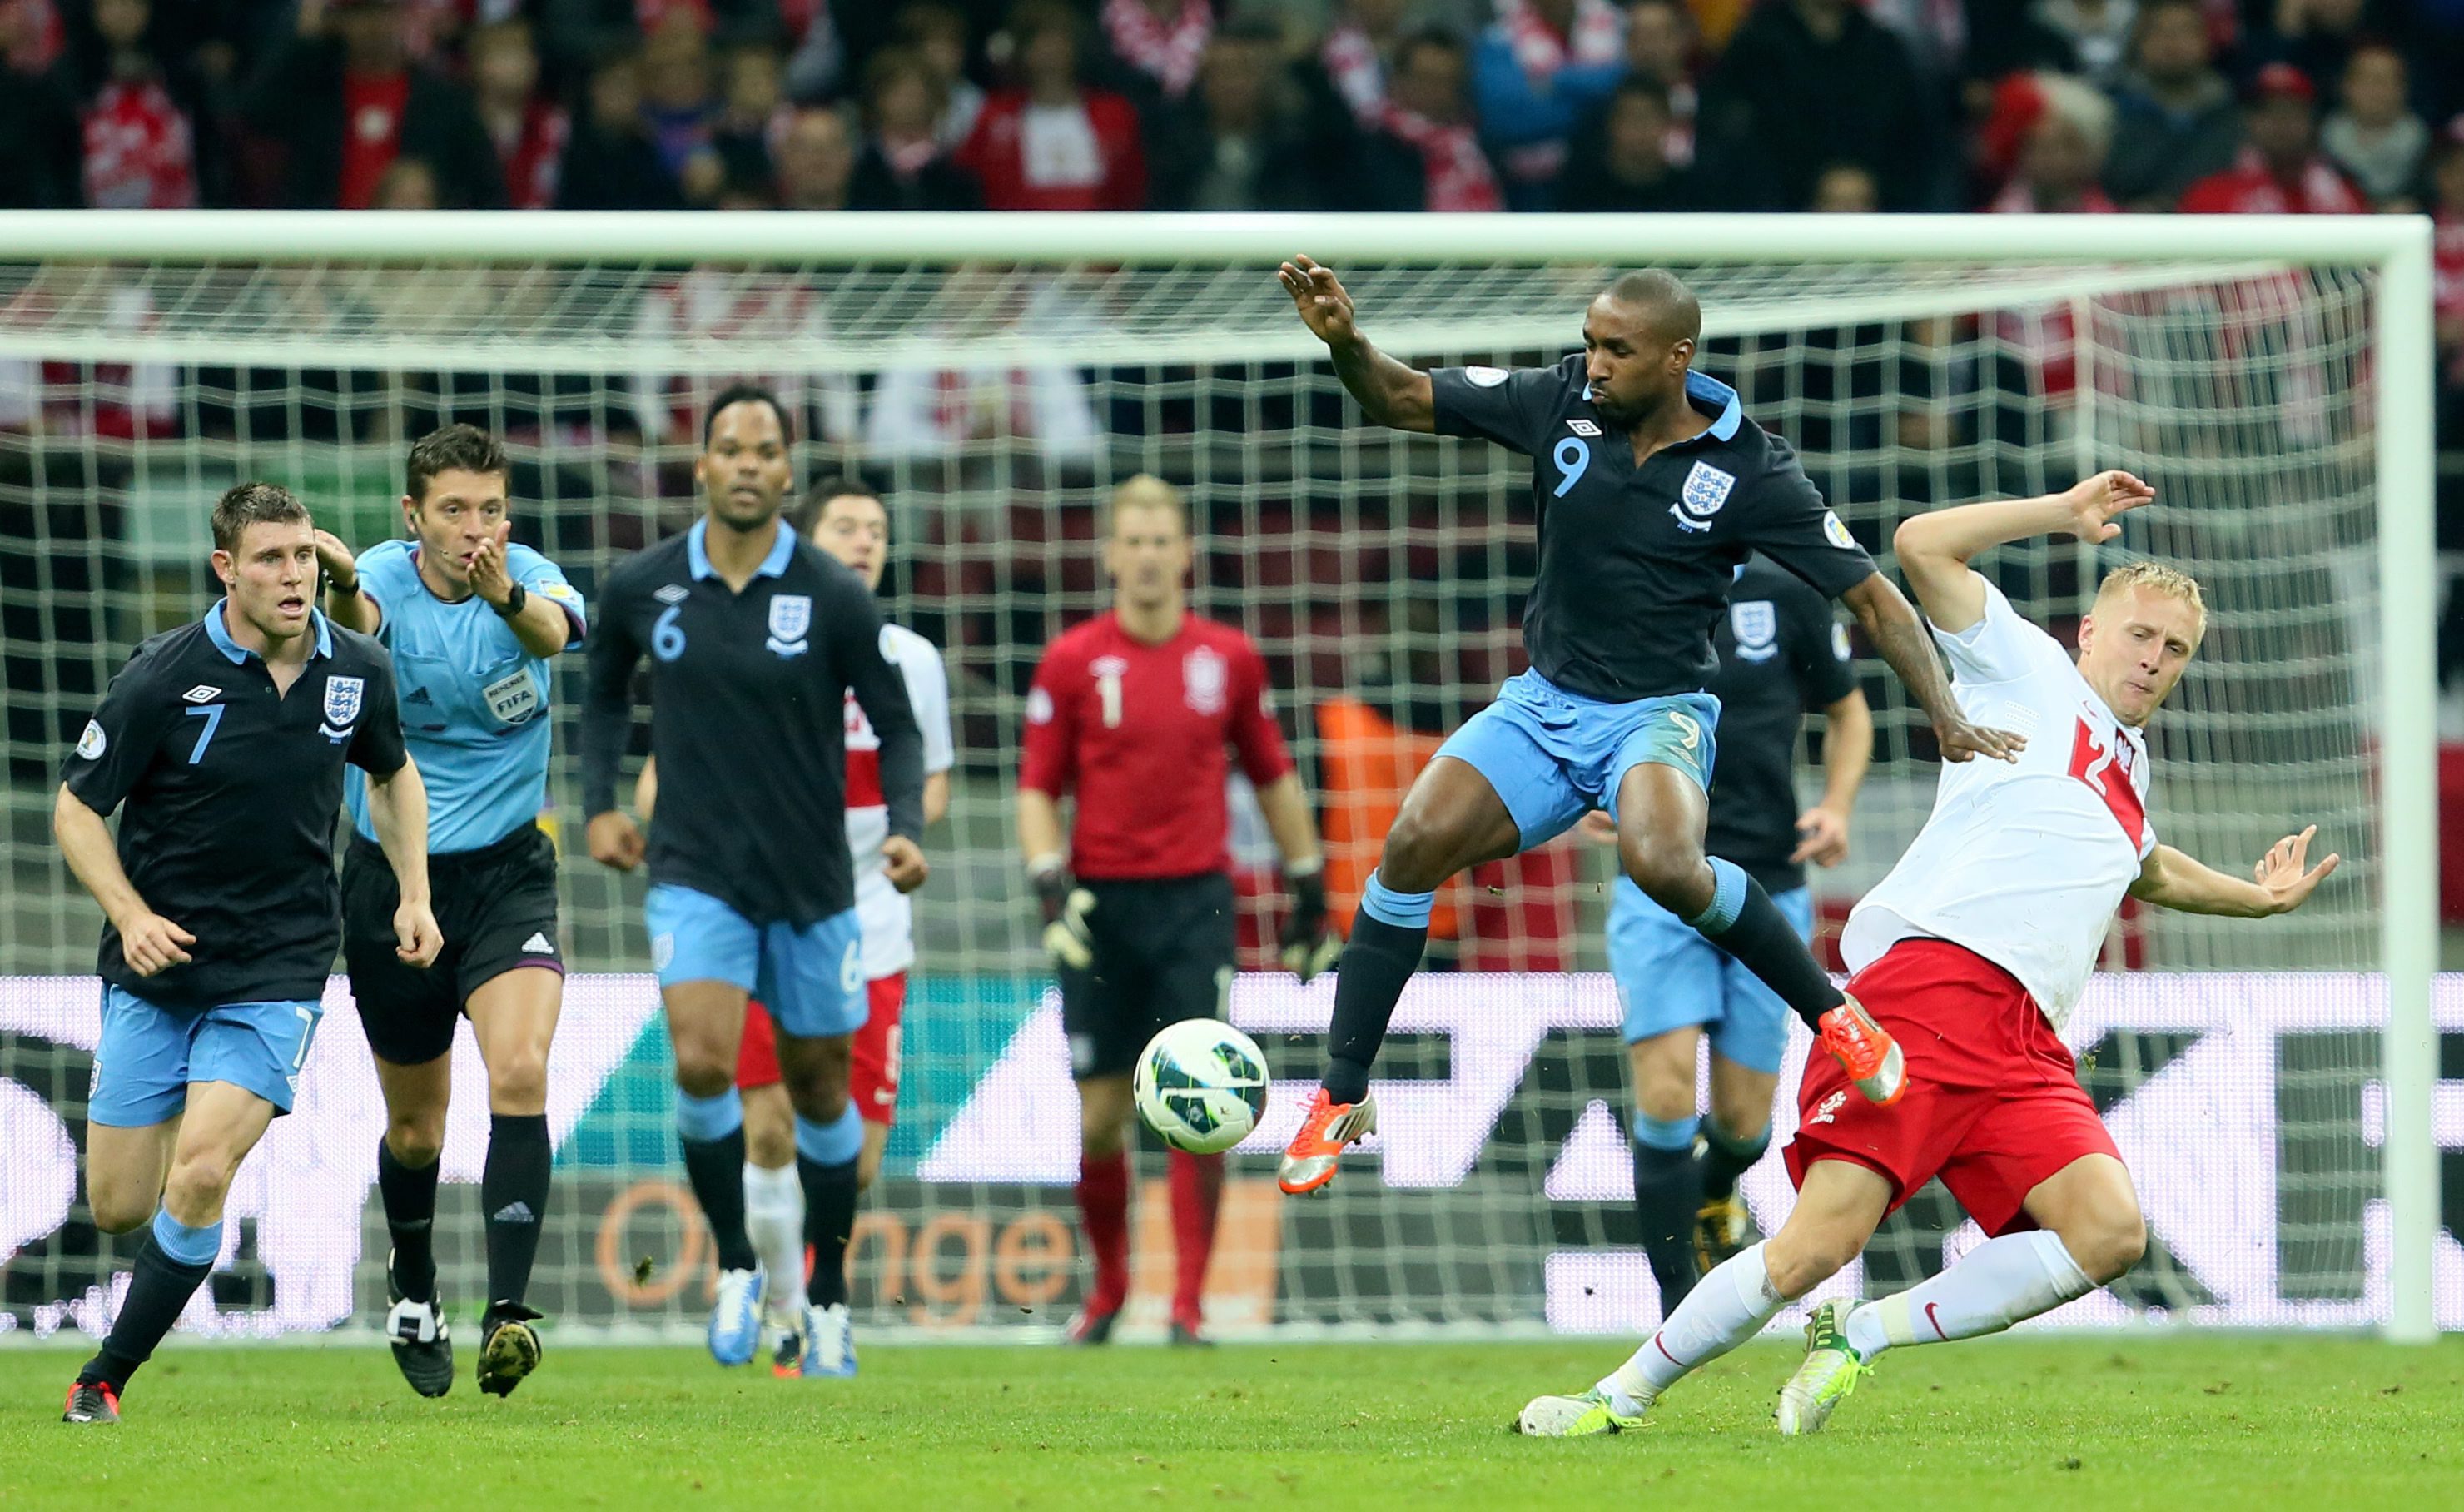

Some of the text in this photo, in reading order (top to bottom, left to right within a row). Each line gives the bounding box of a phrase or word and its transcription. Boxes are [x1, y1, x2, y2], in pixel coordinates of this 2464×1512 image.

[1553, 436, 1590, 498] 9
[652, 605, 687, 663] 6
[497, 689, 534, 714] FIFA
[1095, 673, 1123, 730] 1
[1669, 711, 1700, 749] 9
[185, 704, 226, 764] 7
[2084, 729, 2113, 797] 2
[838, 939, 863, 995] 6
[293, 1005, 314, 1069] 7
[594, 1179, 1073, 1327] Onge
